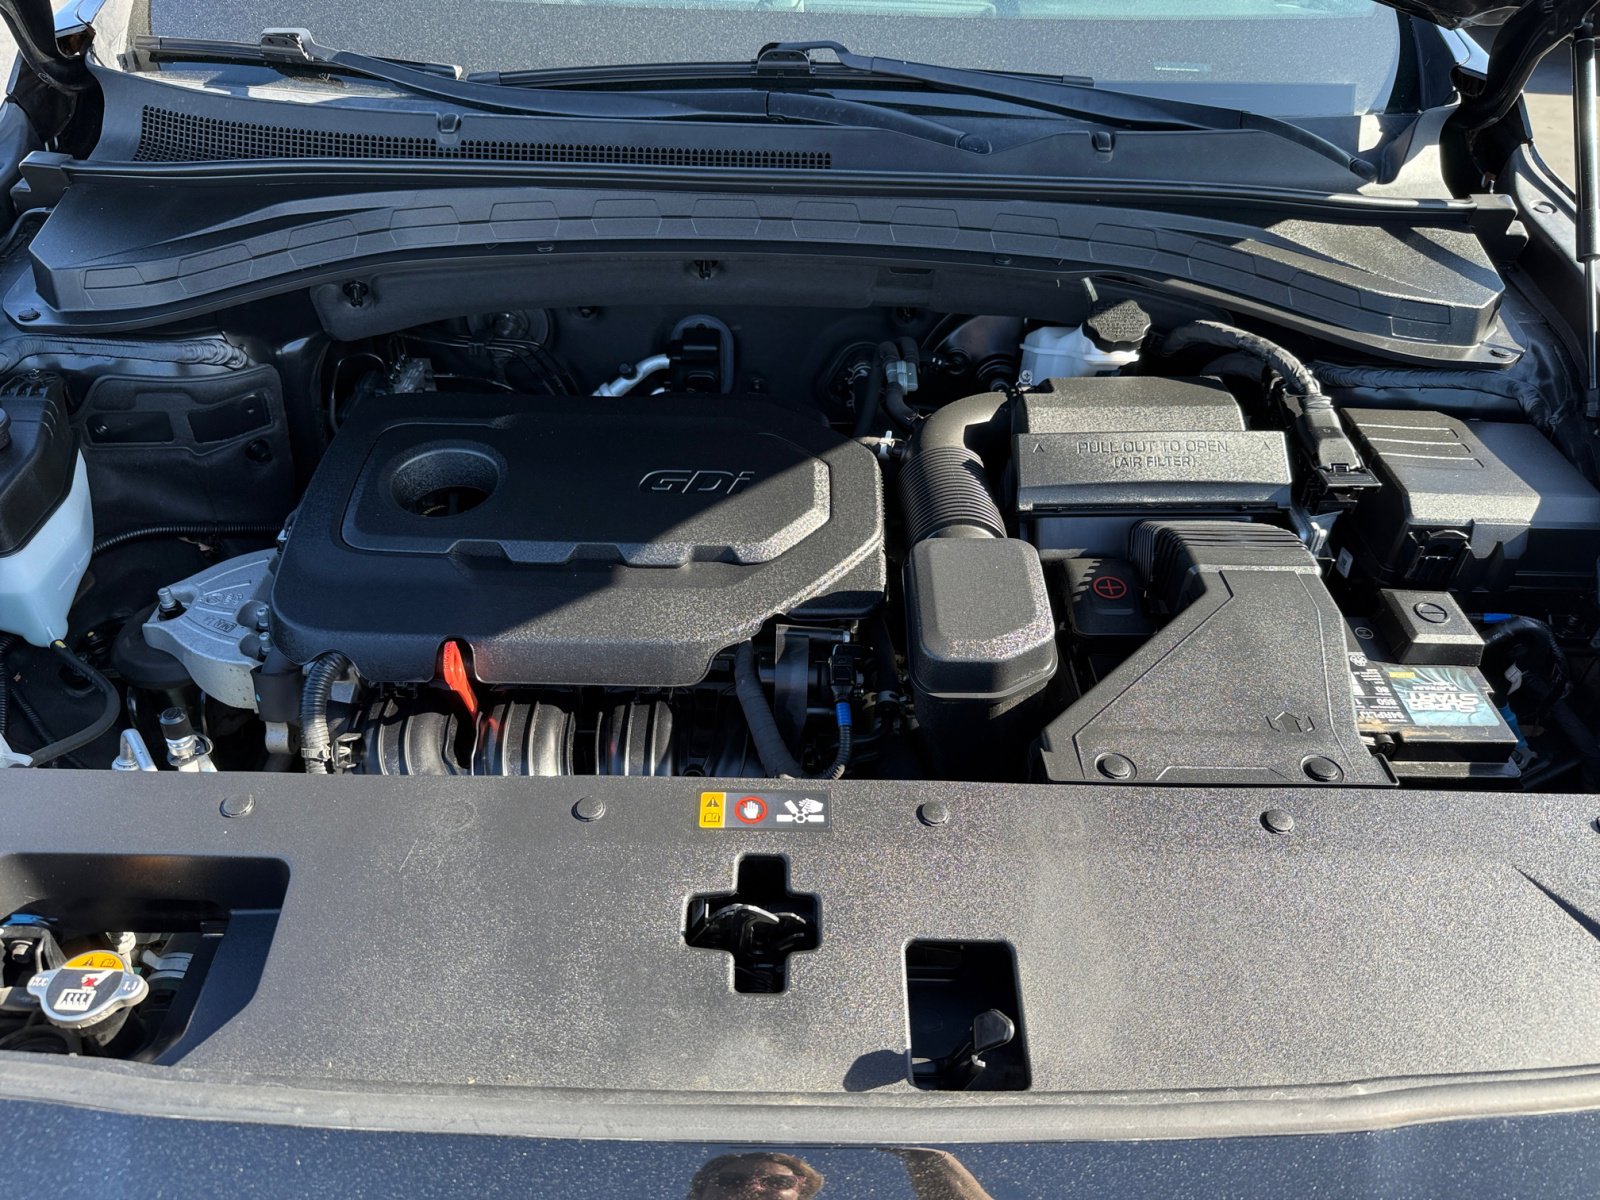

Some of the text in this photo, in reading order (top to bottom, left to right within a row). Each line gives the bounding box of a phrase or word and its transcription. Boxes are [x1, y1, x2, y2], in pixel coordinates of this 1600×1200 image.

[1076, 440, 1229, 455] PULL OUT TO OPEN
[1113, 454, 1197, 469] (AIR FILTER)
[1409, 692, 1480, 705] START
[1407, 701, 1477, 713] SUPER
[122, 981, 138, 991] 1.1
